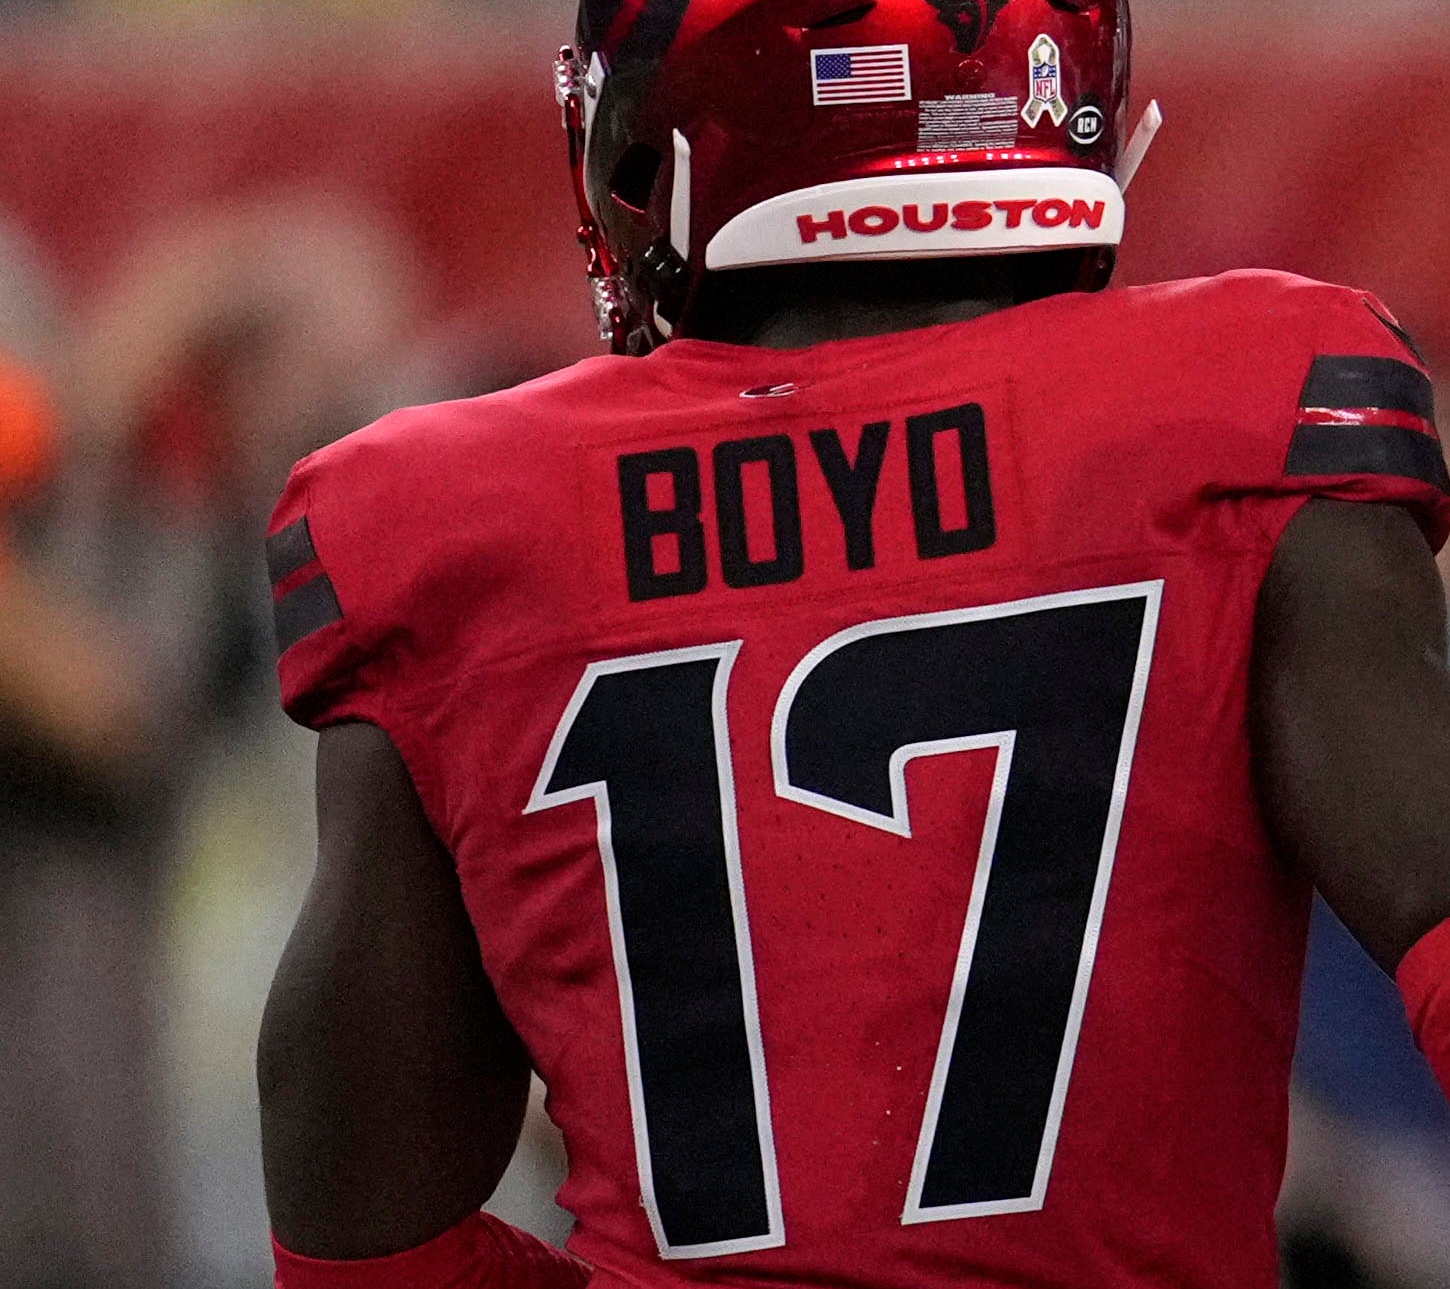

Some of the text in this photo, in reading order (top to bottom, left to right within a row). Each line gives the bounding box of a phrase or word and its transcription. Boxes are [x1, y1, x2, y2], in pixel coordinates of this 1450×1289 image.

[1034, 78, 1056, 99] NFL
[796, 198, 1106, 244] HOUSTON
[616, 402, 998, 603] BOYD
[522, 578, 1165, 1261] 17
